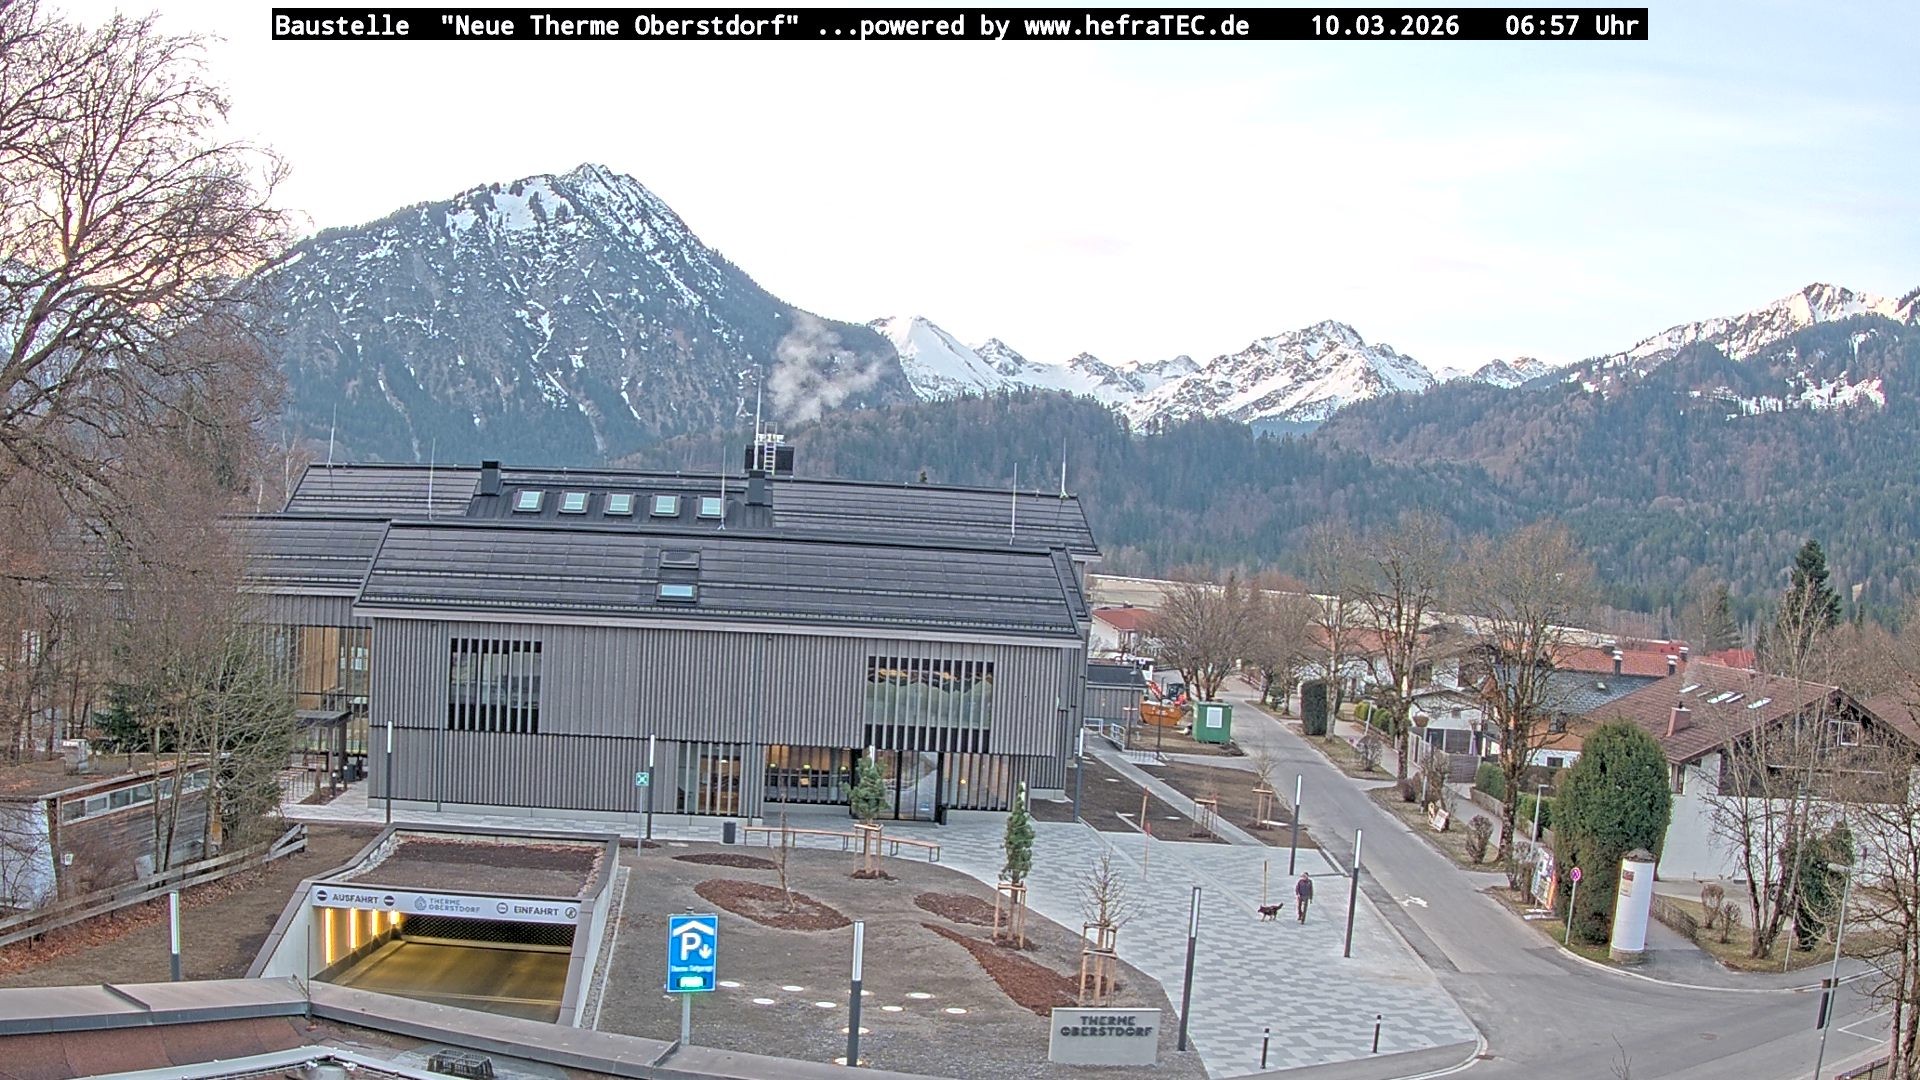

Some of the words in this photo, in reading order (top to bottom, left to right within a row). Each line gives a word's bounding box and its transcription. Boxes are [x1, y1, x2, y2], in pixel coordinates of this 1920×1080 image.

[332, 894, 379, 904] AUSFAHRT
[429, 898, 461, 906] THERME
[428, 904, 480, 913] OBERSTDORF
[513, 905, 559, 916] EINFAHRT
[680, 932, 702, 961] P
[1080, 1015, 1137, 1026] THERME
[1060, 1026, 1153, 1037] OBERSTDORF
